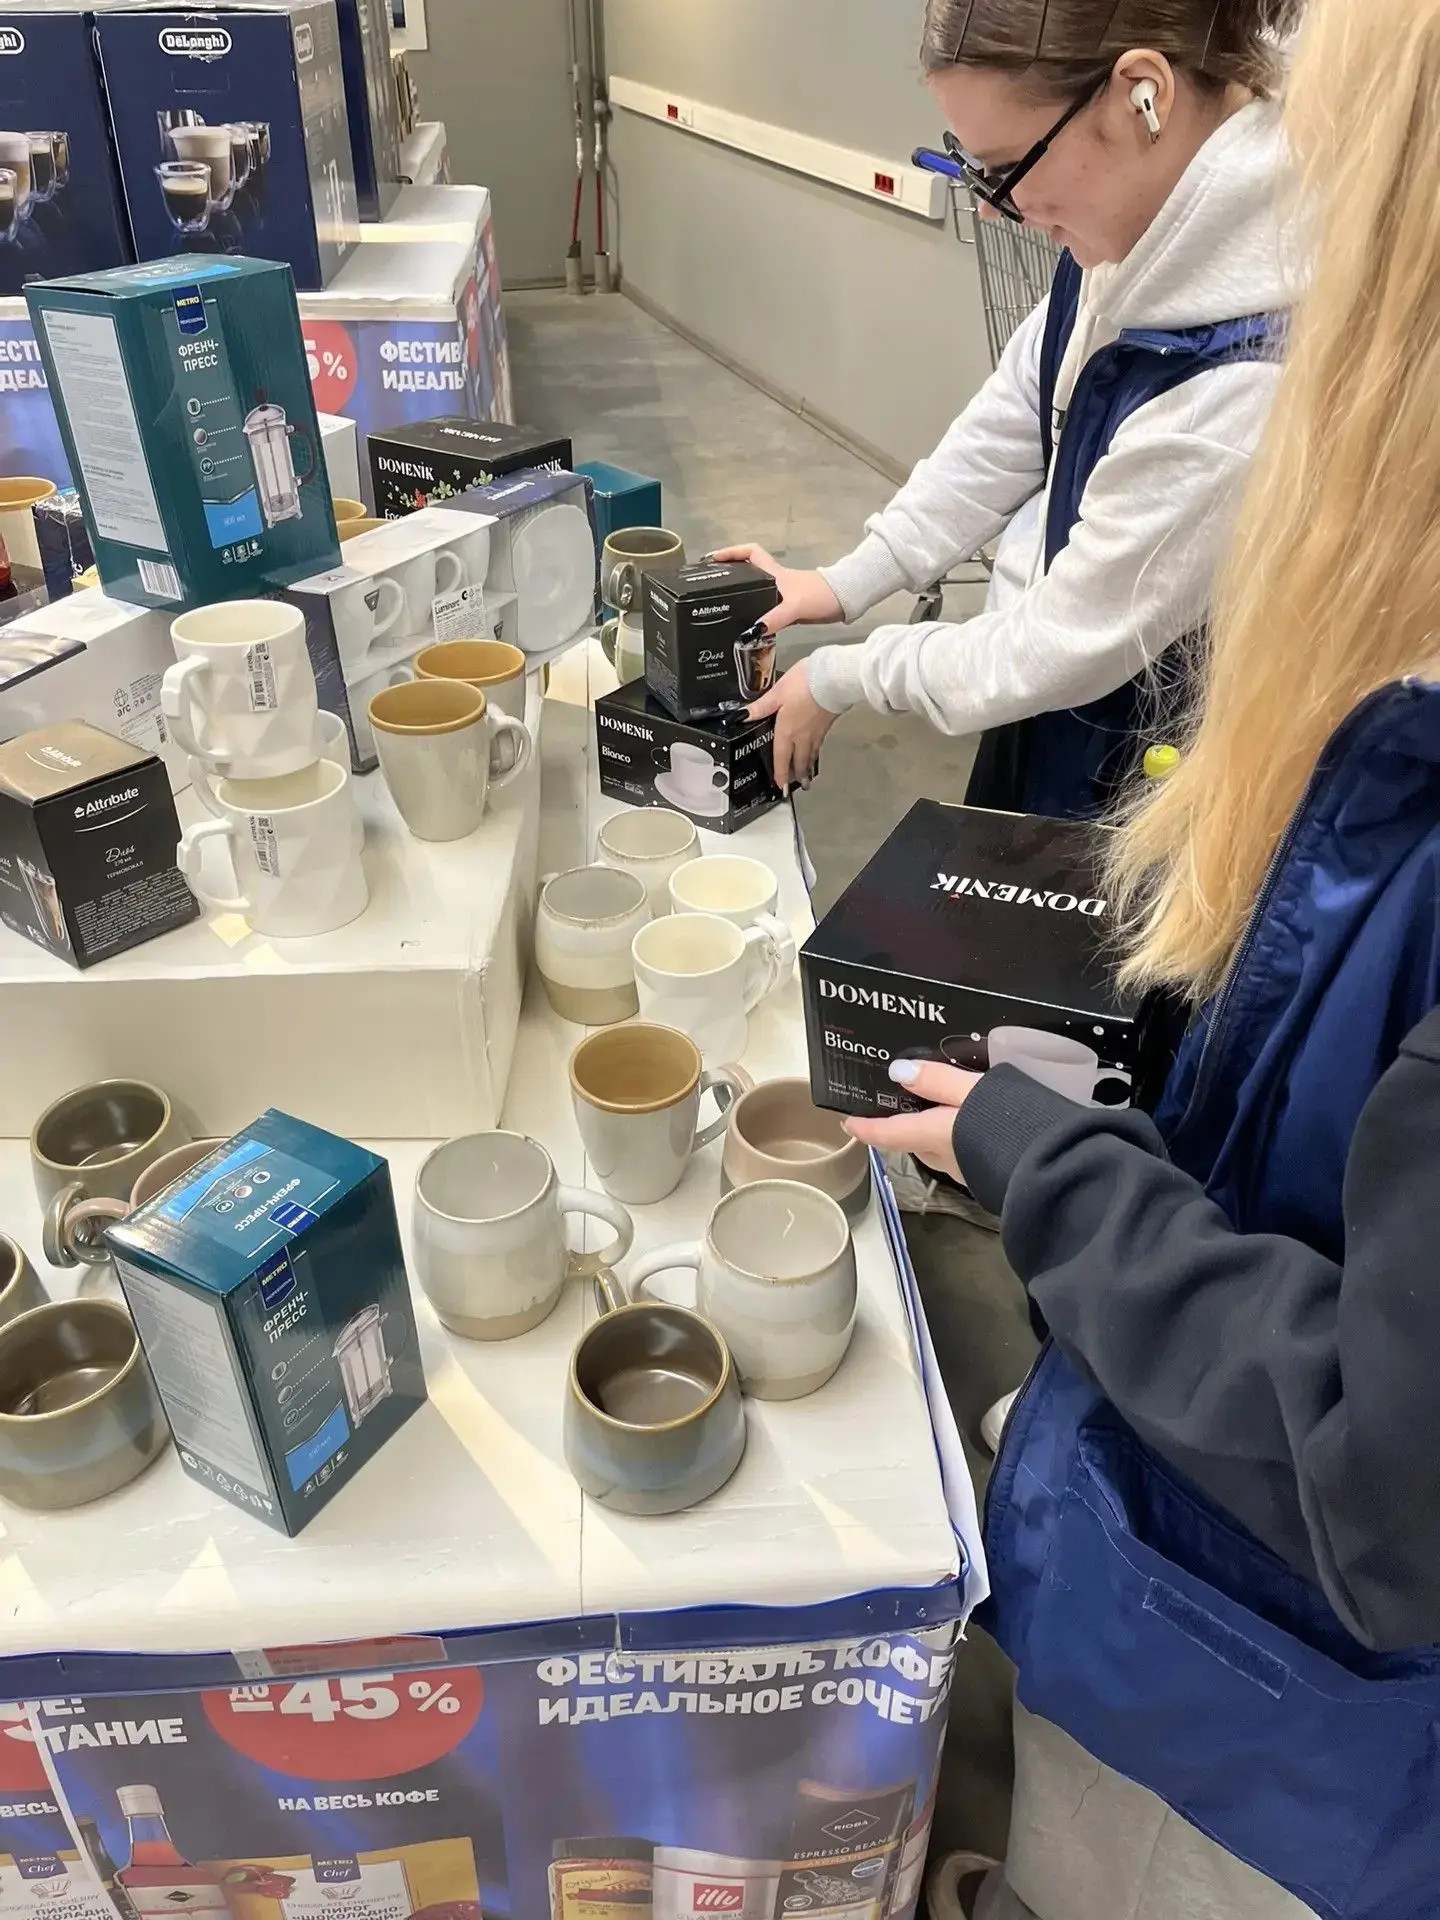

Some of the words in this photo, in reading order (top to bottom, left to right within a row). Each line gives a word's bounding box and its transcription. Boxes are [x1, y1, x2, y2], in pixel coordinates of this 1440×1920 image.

[176, 297, 200, 307] METRO
[178, 339, 219, 357] ФРЕНЧ-
[183, 354, 218, 372] ПРЕСС
[698, 604, 731, 616] Attribute
[116, 704, 132, 718] arc
[601, 744, 632, 765] Bianco
[733, 770, 758, 791] Bianco
[85, 787, 140, 815] Attribute
[824, 1030, 890, 1061] Bianco
[261, 1260, 288, 1286] METRO
[263, 1291, 309, 1332] ФРЕНЧ-
[269, 1304, 308, 1344] ПРЕСС
[536, 1650, 826, 1687] ФЕСТИВАЛЬ
[538, 1684, 804, 1725] ИДЕАЛЬНОЕ
[42, 1717, 188, 1754] ТАНИЕ
[278, 1797, 311, 1811] НА
[314, 1794, 373, 1811] ВЕСЬ
[375, 1789, 440, 1807] КОФЕ
[0, 1802, 59, 1818] ВЕСЬ
[834, 1820, 868, 1831] RIOBA
[793, 1846, 850, 1860] ESPRESSO
[28, 1863, 56, 1874] Chef
[316, 1859, 354, 1867] METRO
[323, 1868, 351, 1878] Chef
[696, 1888, 740, 1909] illy
[35, 1903, 86, 1916] ПИРОГ
[321, 1904, 371, 1915] ПИРОГ
